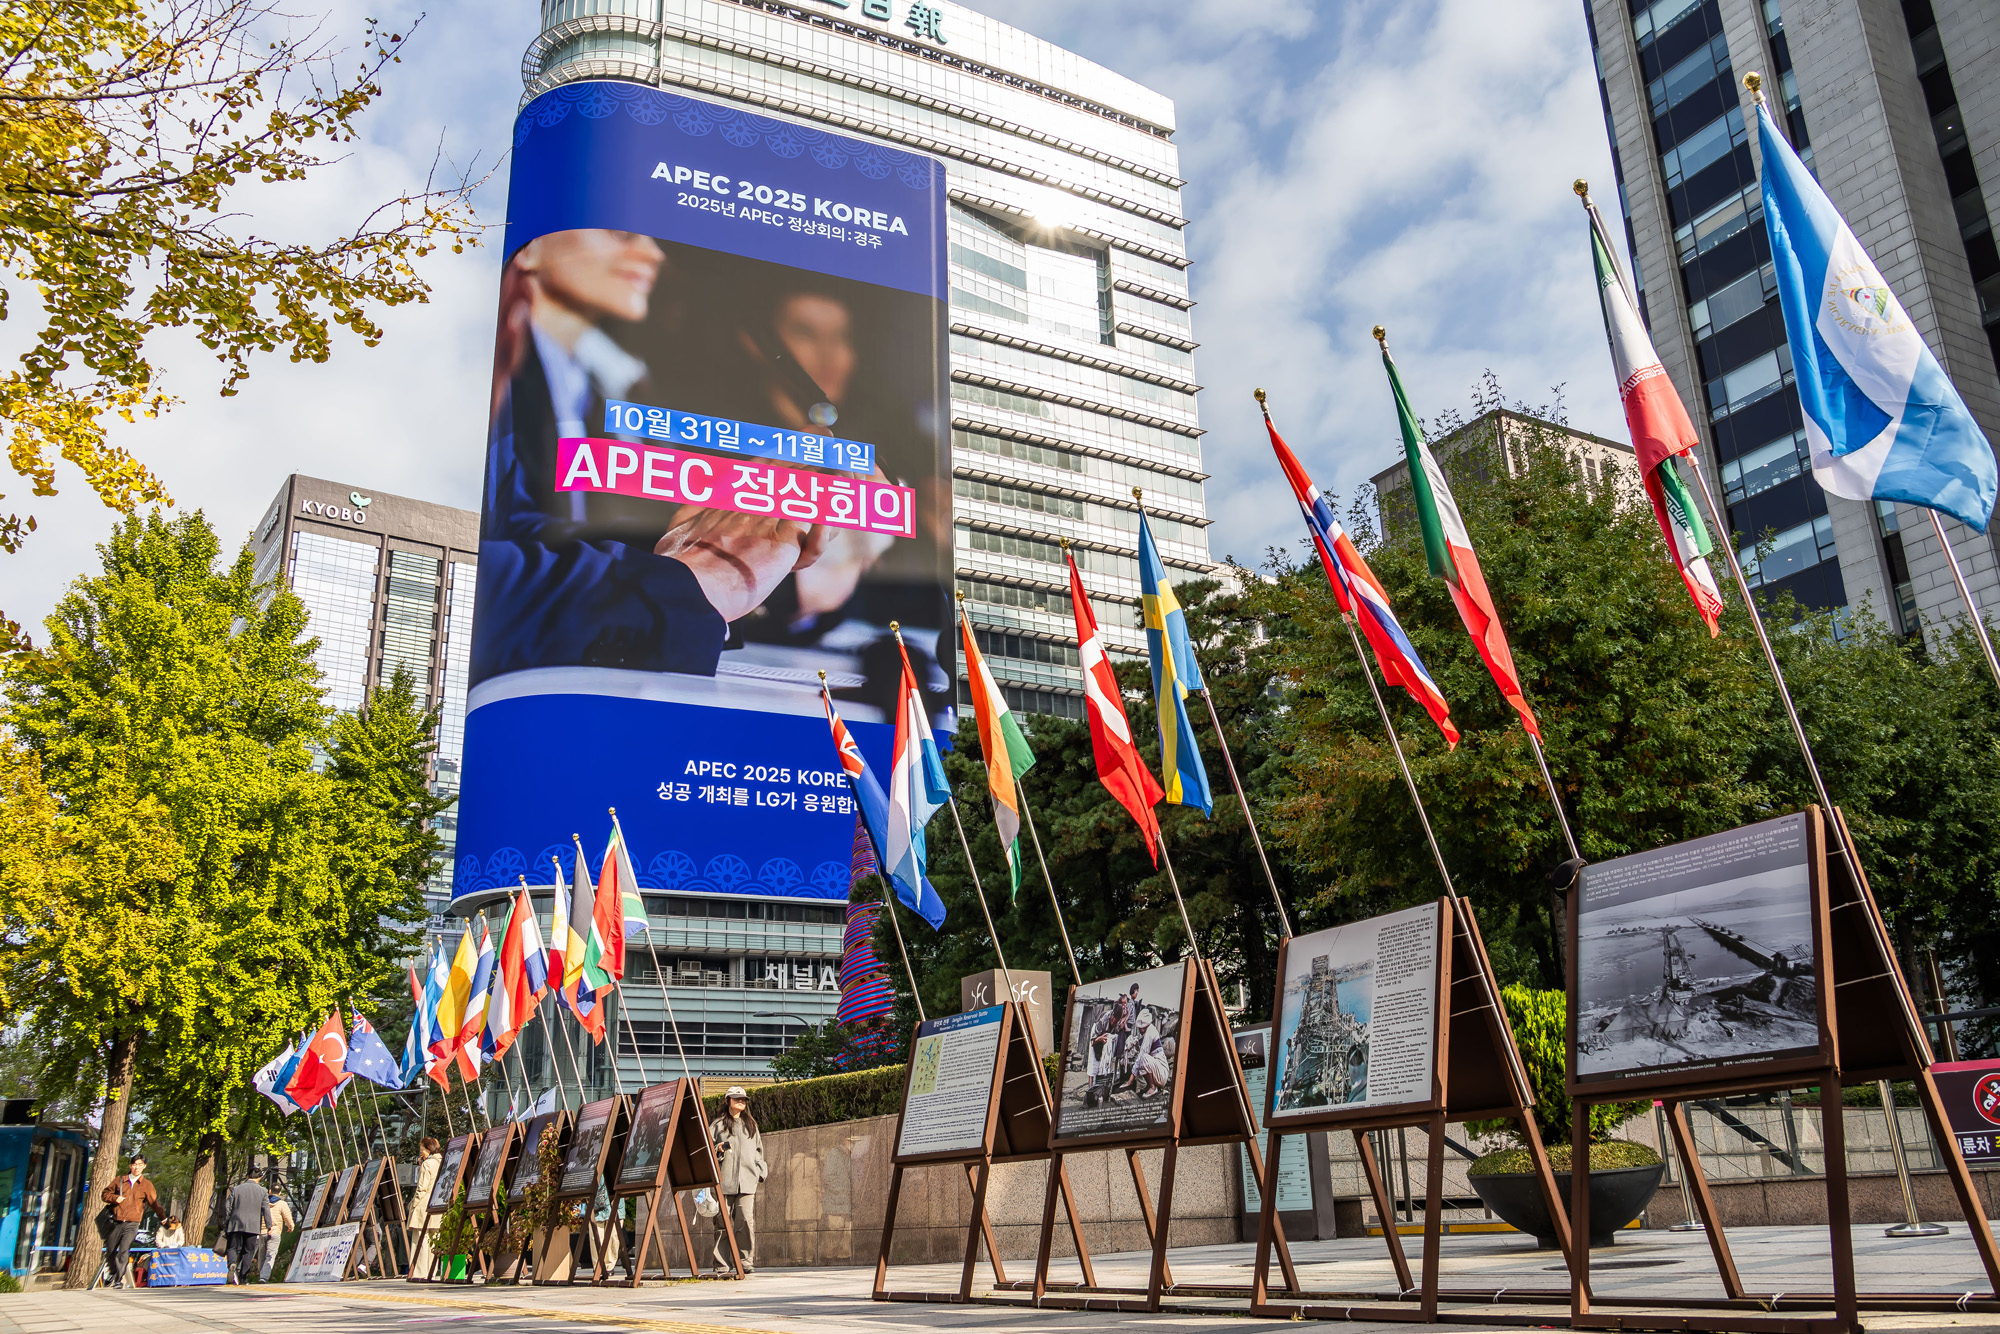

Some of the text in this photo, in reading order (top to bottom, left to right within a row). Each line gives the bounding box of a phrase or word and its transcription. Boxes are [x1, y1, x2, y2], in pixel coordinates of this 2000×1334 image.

[650, 161, 909, 236] APEC 2025 KOREA
[677, 192, 736, 218] 2025년
[739, 206, 784, 227] APEC
[609, 405, 870, 472] 10월 31일 ~ 11월 1일
[562, 443, 912, 535] APEC 정상회의
[302, 500, 366, 524] KYOBO
[684, 760, 852, 789] APEC 2025 KORE
[656, 781, 692, 802] 성공
[698, 785, 750, 806] 개최를
[756, 790, 798, 810] LG가
[765, 963, 839, 991] 채널A
